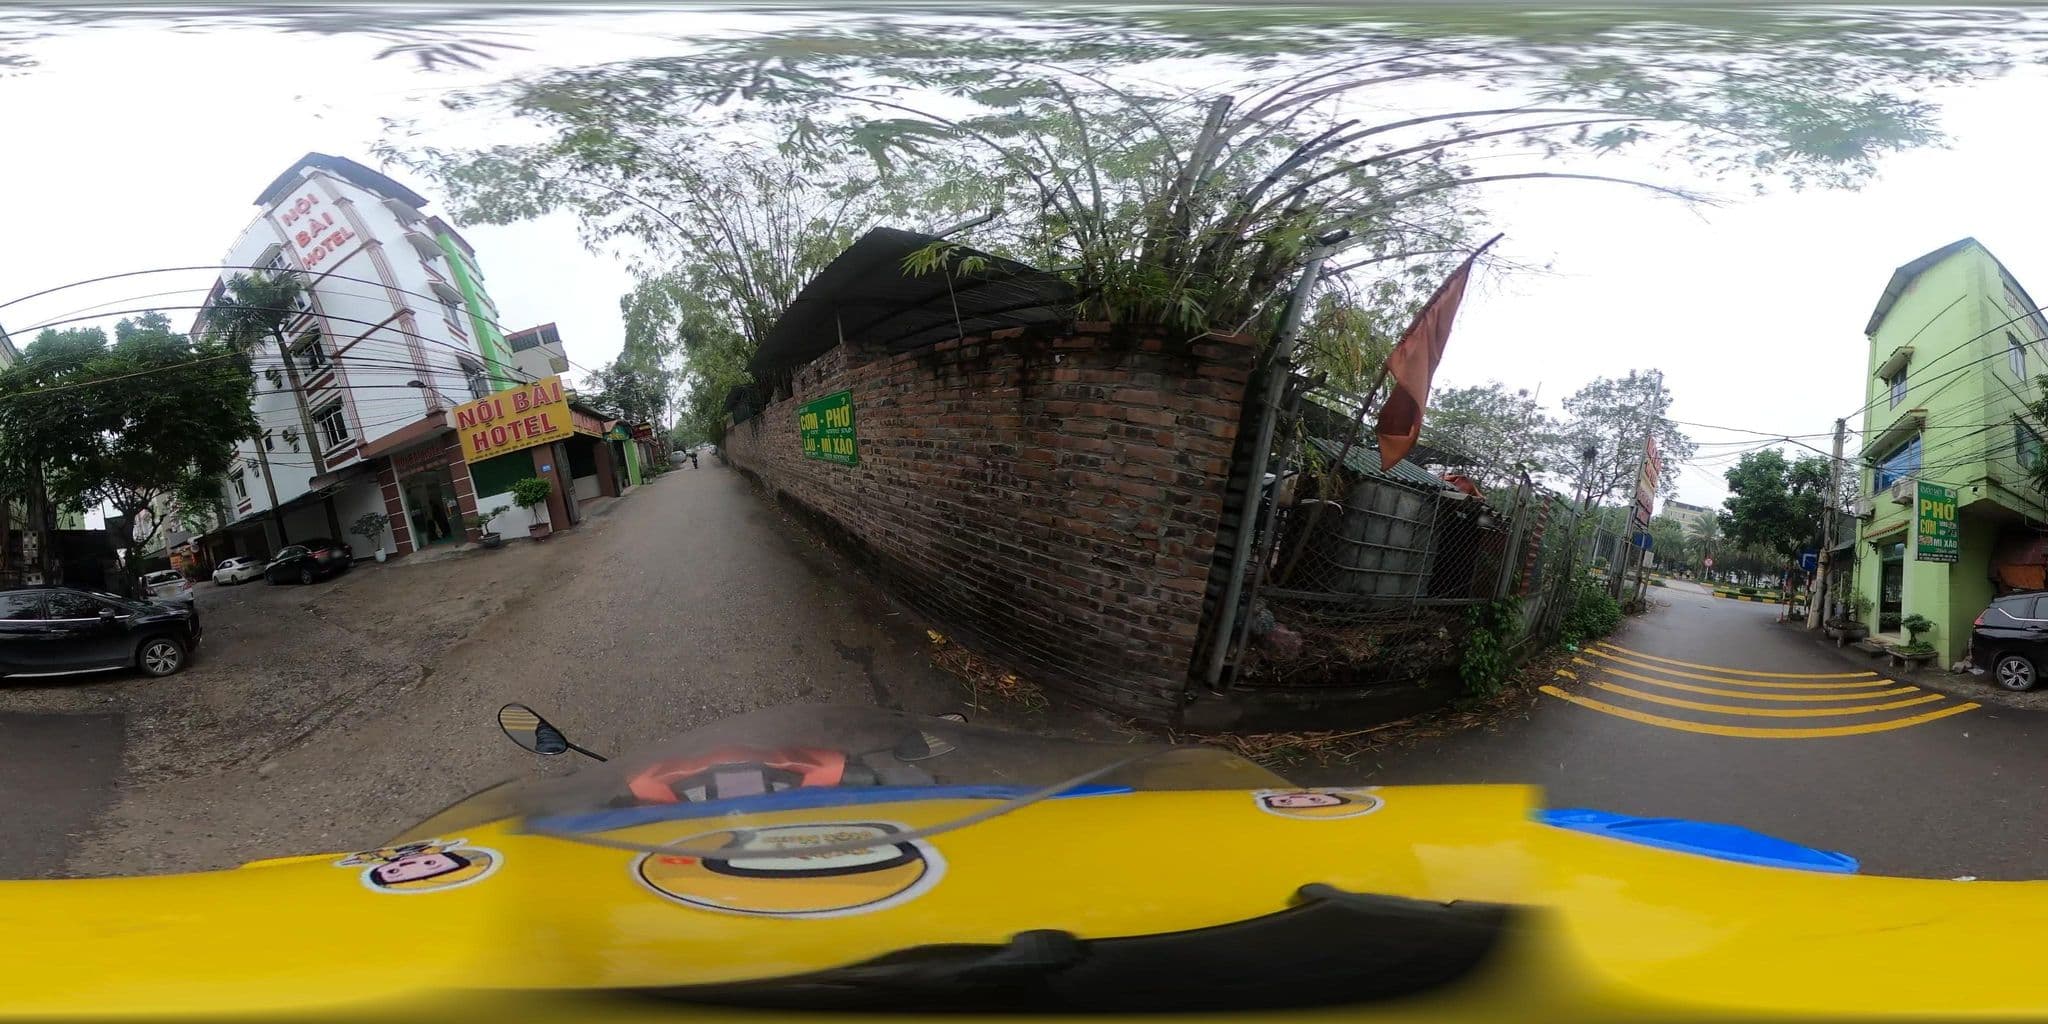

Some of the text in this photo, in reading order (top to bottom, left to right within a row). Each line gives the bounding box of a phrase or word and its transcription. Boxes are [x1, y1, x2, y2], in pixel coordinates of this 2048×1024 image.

[302, 227, 355, 270] HOTEL
[457, 381, 562, 430] NỘI BÀI
[826, 397, 850, 428] PHỞ
[472, 413, 557, 454] HOTEL
[1920, 498, 1955, 521] PHỞ
